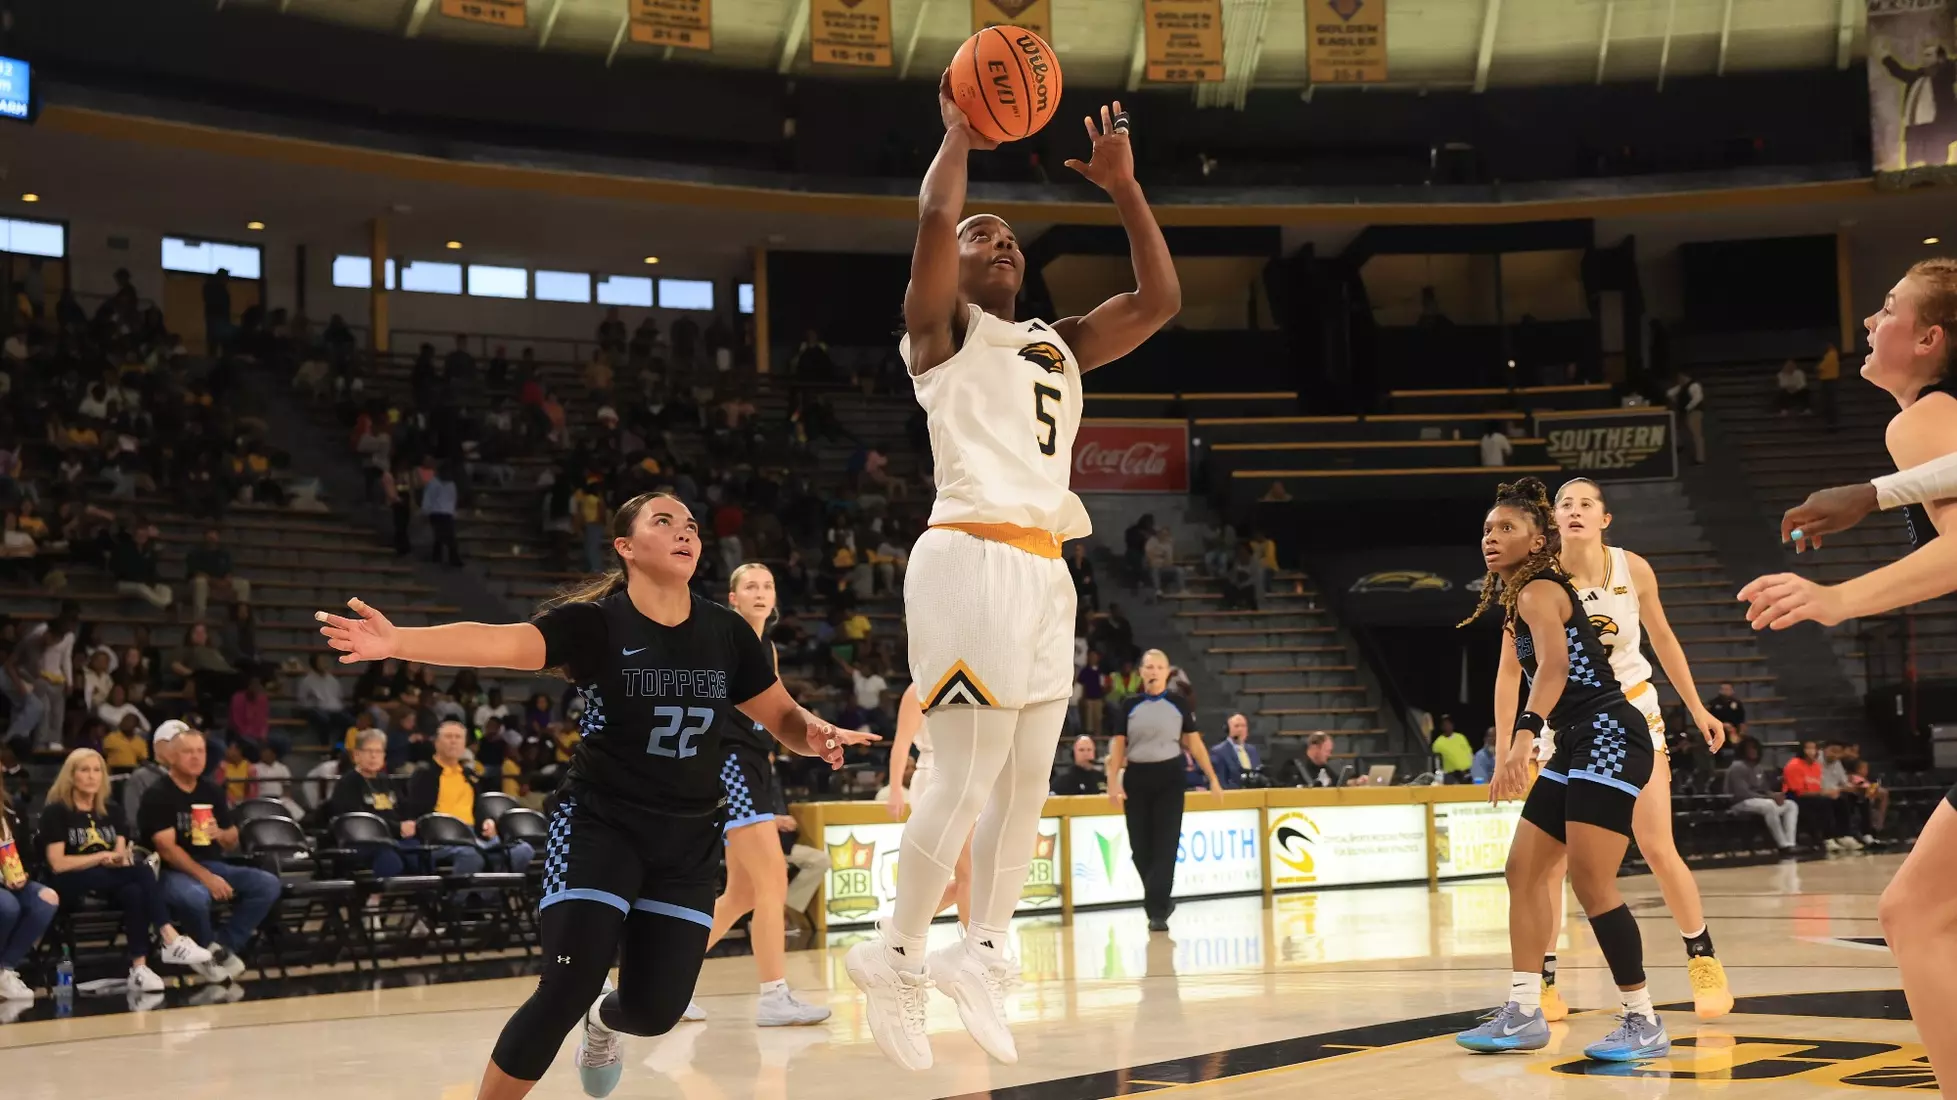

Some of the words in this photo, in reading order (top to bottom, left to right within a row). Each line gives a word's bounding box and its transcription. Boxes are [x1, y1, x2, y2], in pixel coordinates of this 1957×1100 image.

[1316, 24, 1378, 33] GOLDEN
[1317, 37, 1377, 46] EAGLES
[988, 61, 1016, 104] EVO
[1016, 35, 1048, 112] Wilson
[1034, 381, 1062, 456] 5
[1546, 425, 1666, 452] SOUTHERN
[1075, 441, 1170, 476] Coca-Cola
[1578, 450, 1625, 469] MISS
[622, 668, 727, 699] TOPPERS
[646, 706, 714, 759] 22
